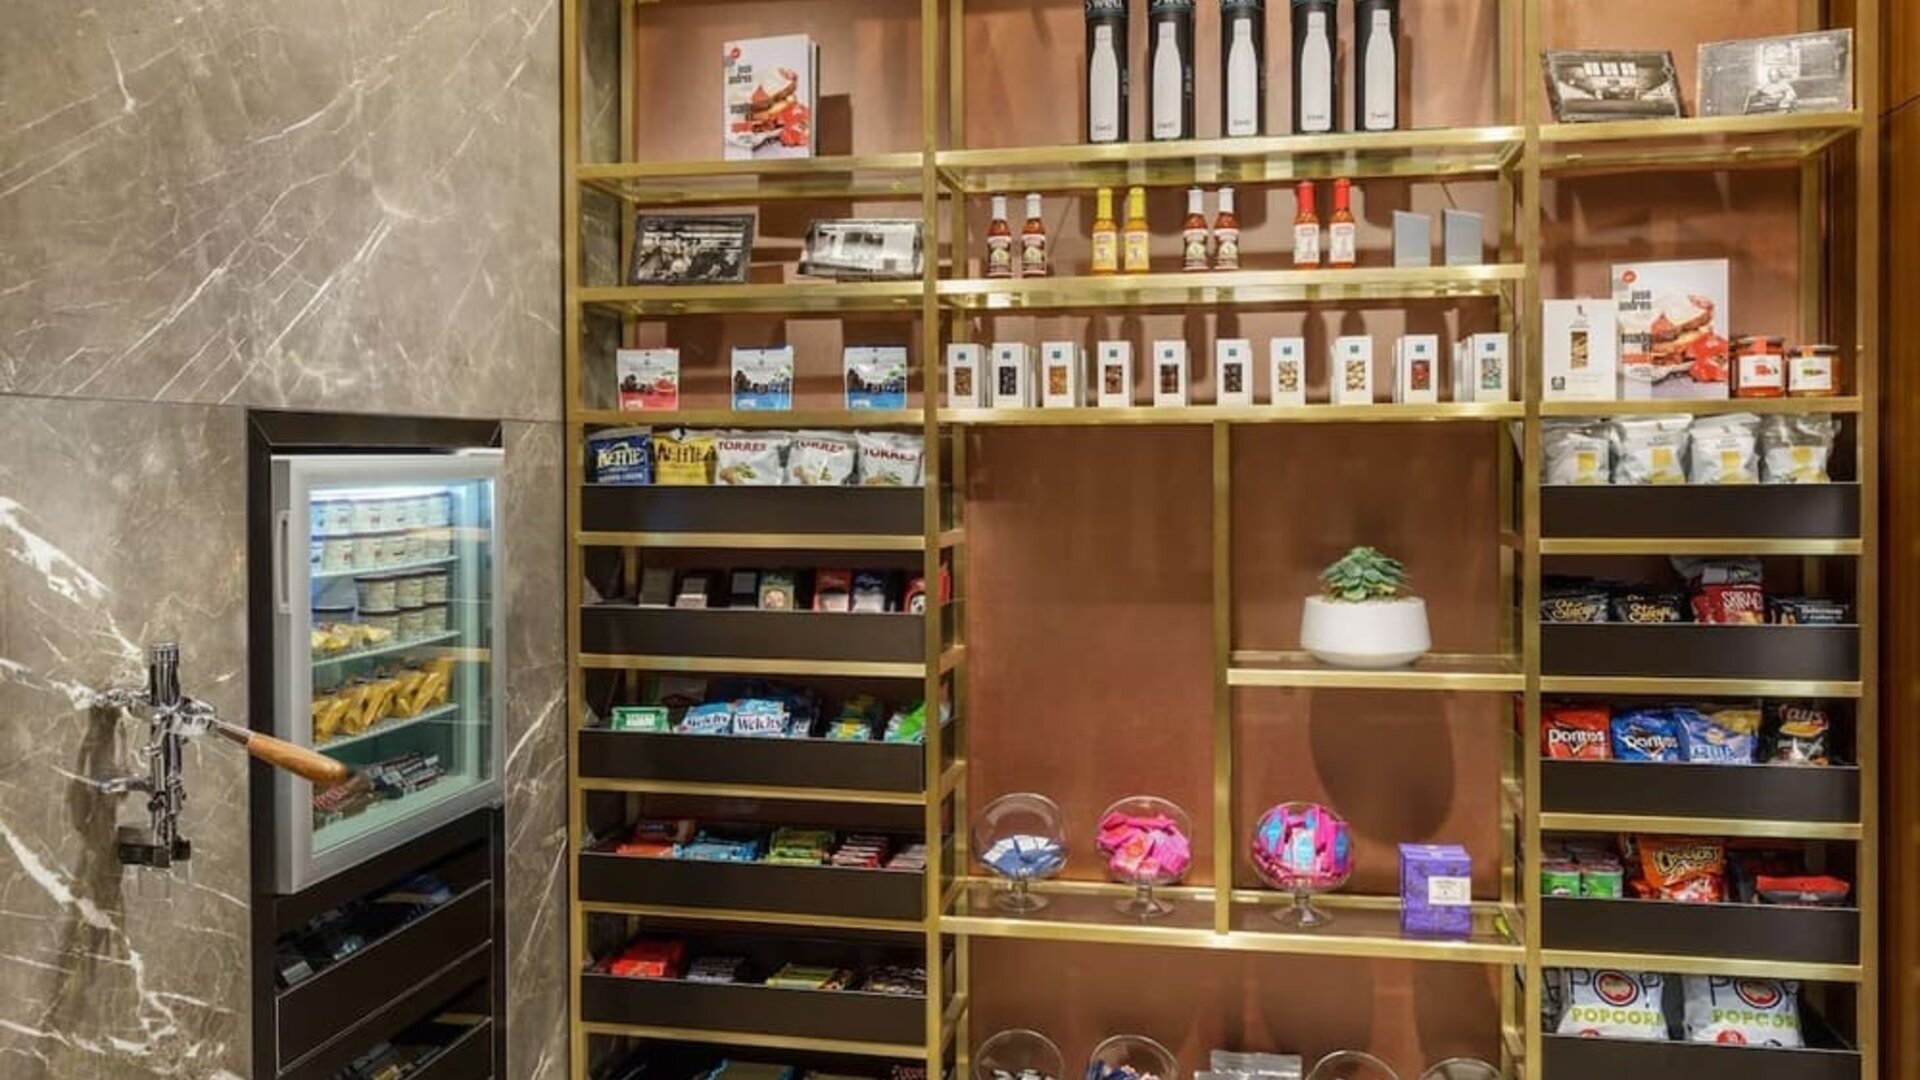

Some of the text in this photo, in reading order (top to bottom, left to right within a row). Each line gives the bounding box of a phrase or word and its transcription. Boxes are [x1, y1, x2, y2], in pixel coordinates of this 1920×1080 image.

[719, 442, 766, 452] TORRES
[1548, 729, 1605, 744] Doritos
[1624, 734, 1678, 749] Doritos
[1713, 1009, 1797, 1029] POPCOR
